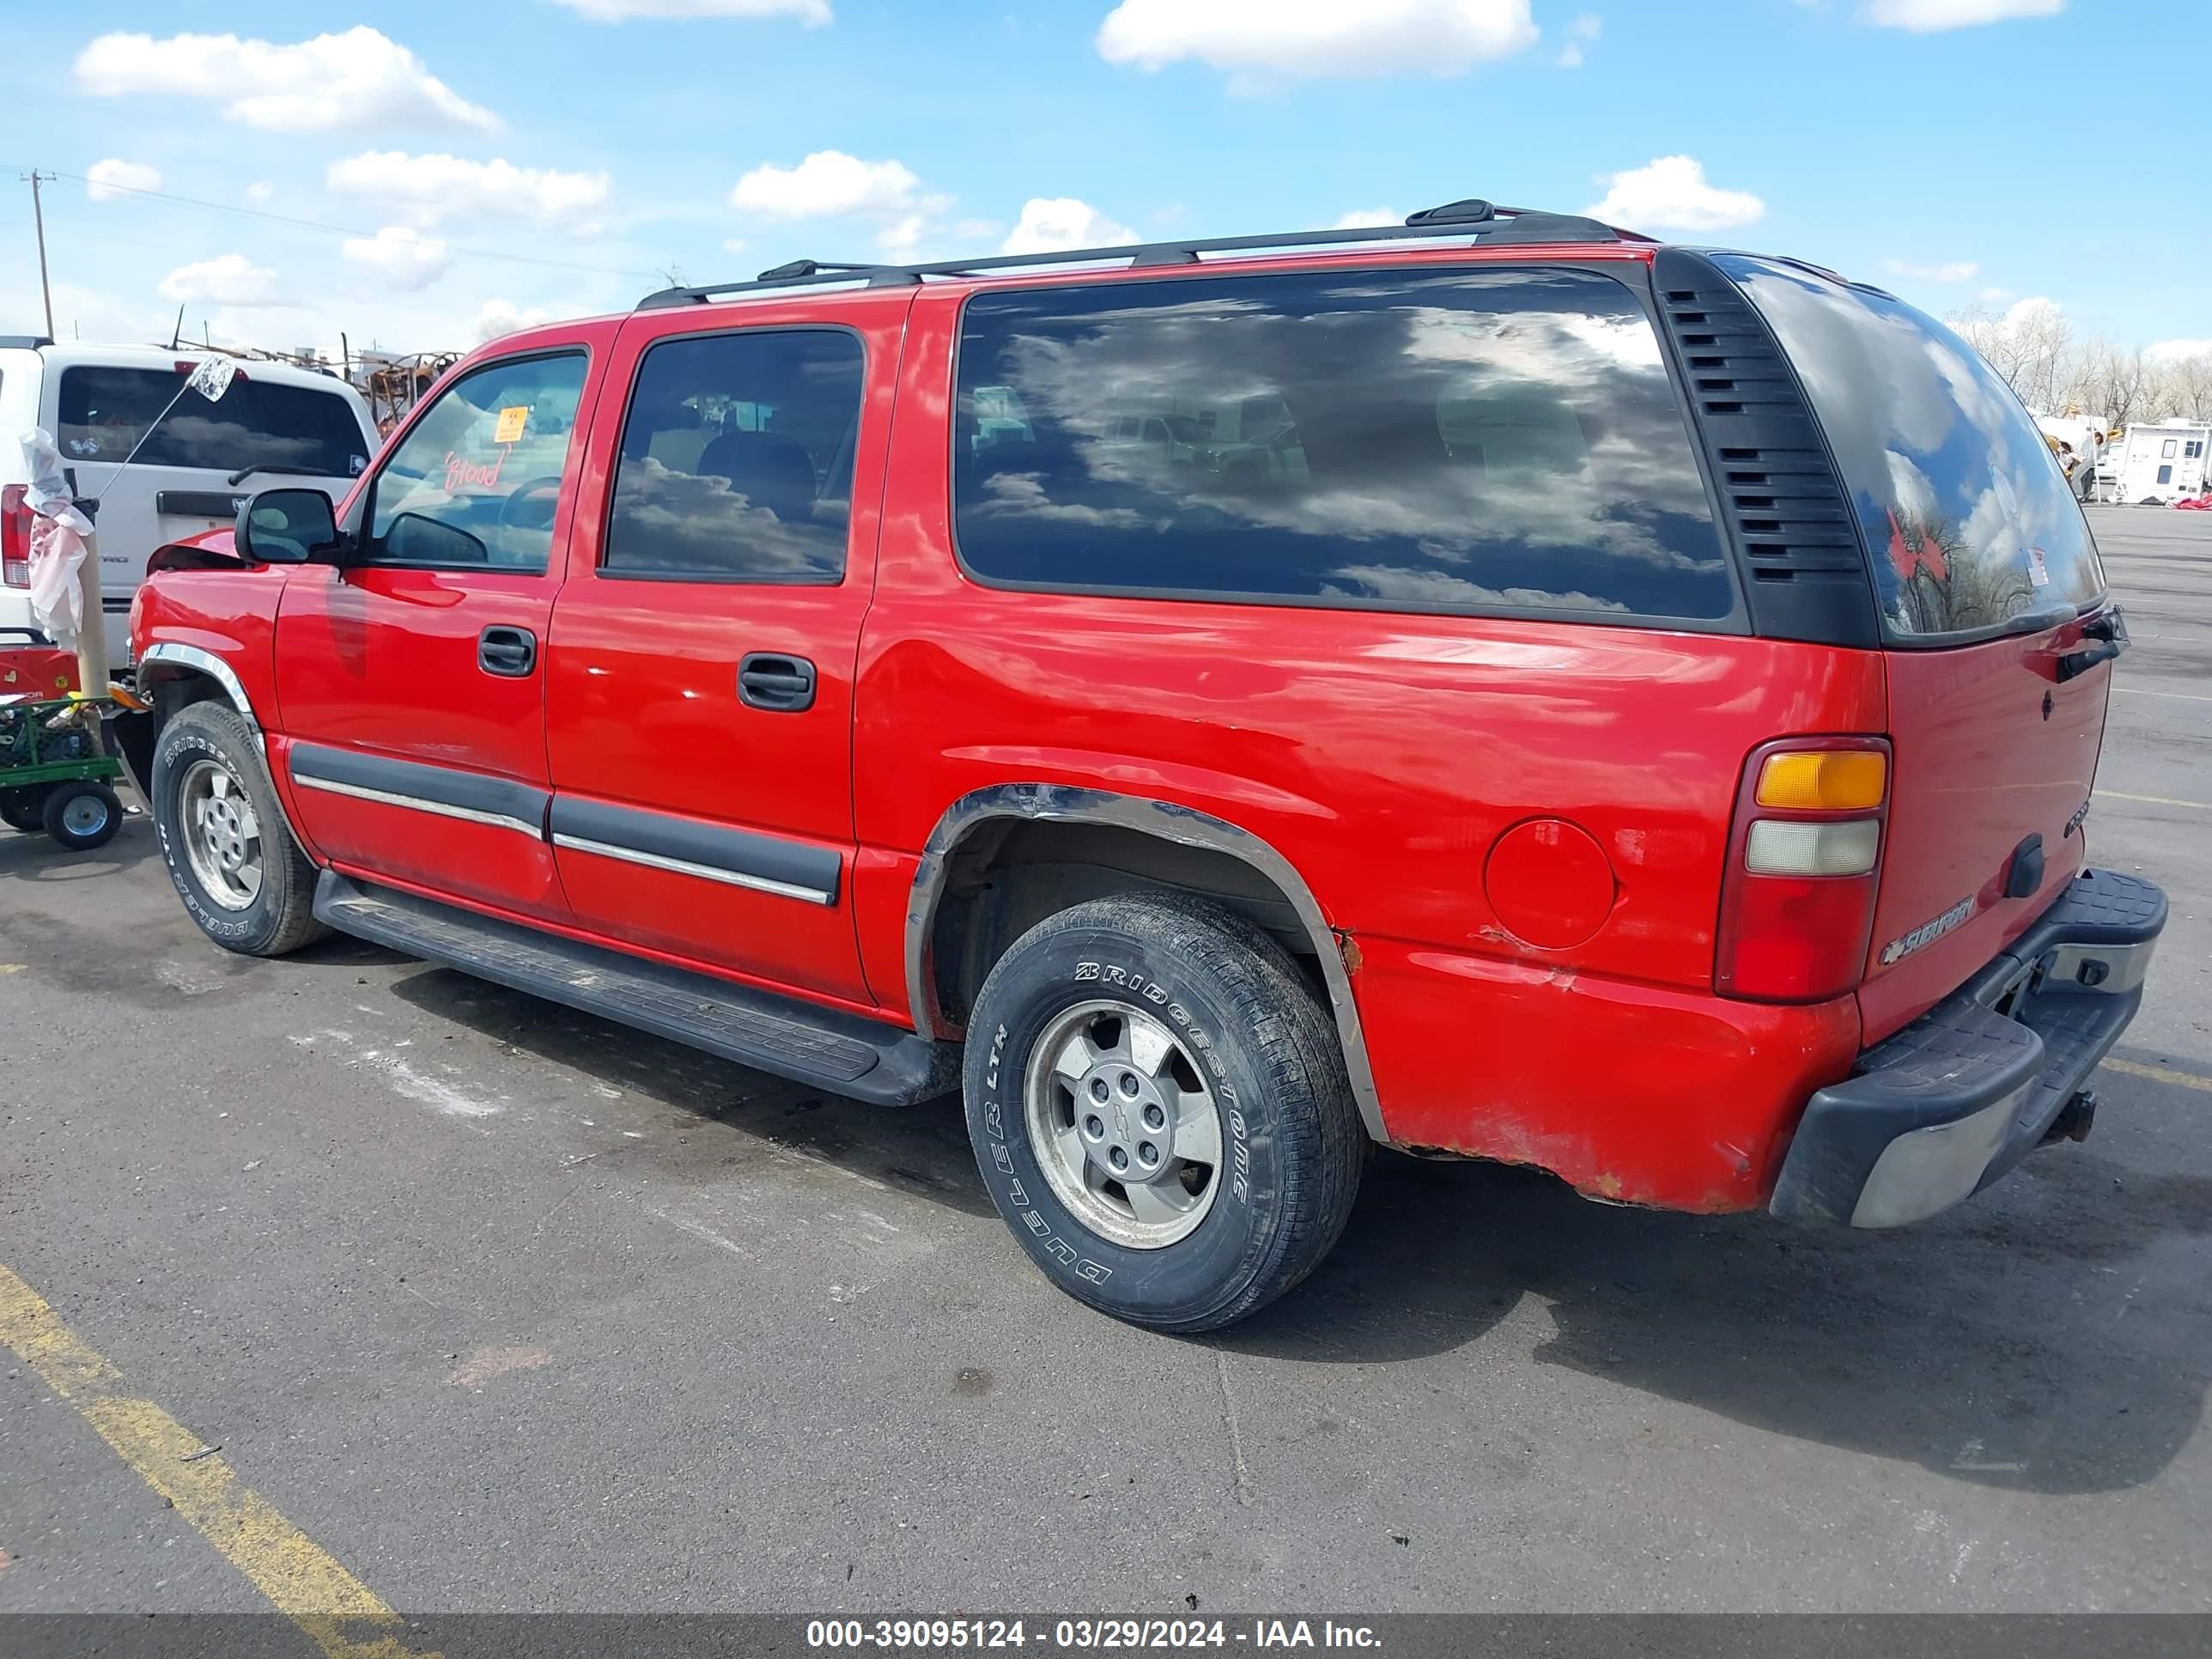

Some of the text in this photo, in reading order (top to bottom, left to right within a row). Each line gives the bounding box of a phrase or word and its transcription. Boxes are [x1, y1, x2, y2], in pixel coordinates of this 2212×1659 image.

[173, 872, 249, 936] DUELER
[1902, 896, 1975, 956] SUBURBAN
[1074, 962, 1251, 1205] BRIDGESTONE
[984, 1100, 1114, 1285] DUELER
